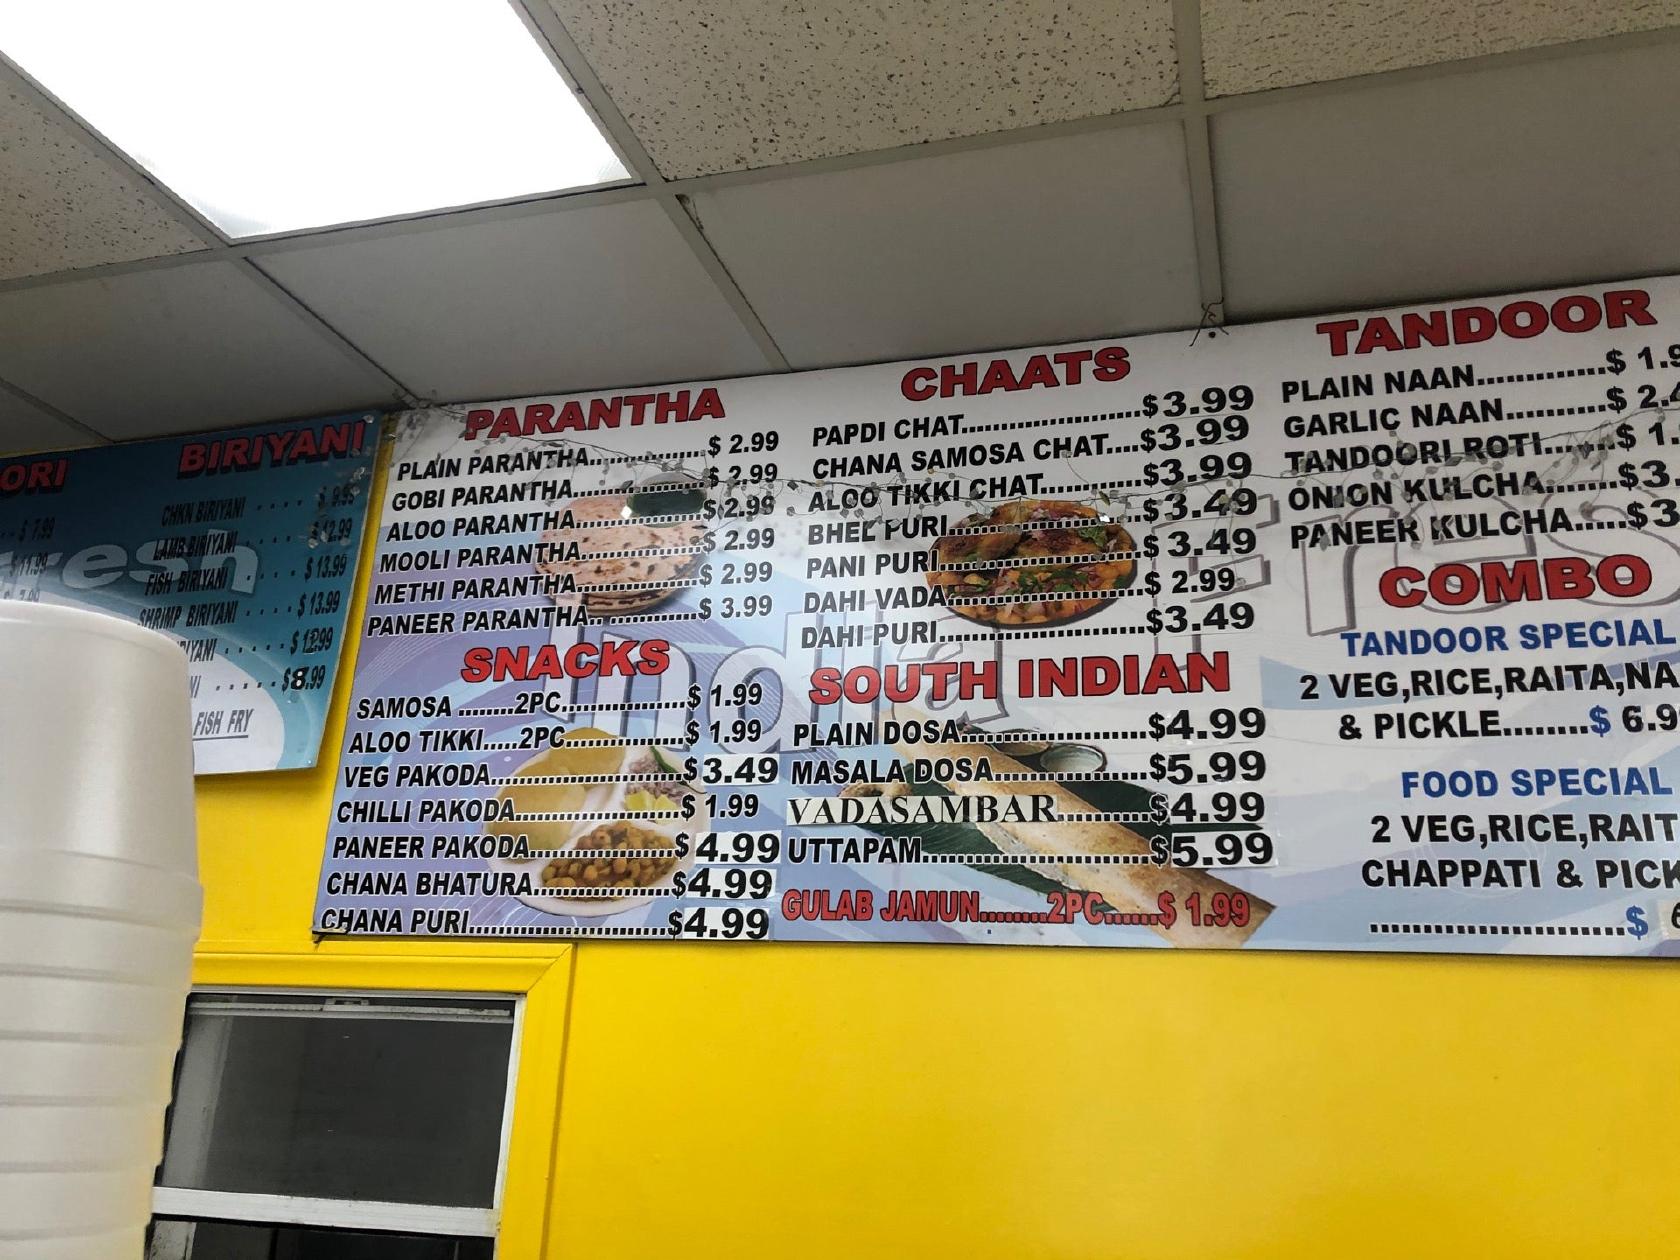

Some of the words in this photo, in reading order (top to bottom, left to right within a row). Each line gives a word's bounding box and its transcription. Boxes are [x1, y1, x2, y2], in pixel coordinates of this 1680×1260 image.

[1316, 290, 1658, 357] TANDOOR
[901, 347, 1131, 401] CHAATS
[1281, 374, 1372, 403] PLAIN
[1385, 364, 1474, 395] NAAN
[1606, 349, 1626, 376] $
[465, 388, 725, 440] PARANTHA
[812, 421, 886, 447] PAPDI
[894, 414, 963, 438] CHAT
[1284, 408, 1400, 439] GARLIC
[1412, 399, 1503, 428] NAAN
[1606, 386, 1627, 413] $
[177, 420, 366, 479] BIRIYANI
[399, 458, 461, 481] PLAIN
[467, 448, 589, 476] PARANTHA
[708, 435, 720, 457] $
[730, 431, 779, 455] 2.99
[813, 452, 901, 480] CHANA
[911, 442, 1024, 472] SAMOSA
[1033, 433, 1108, 459] CHAT
[1285, 439, 1451, 473] TANDOORI
[1463, 432, 1541, 459] ROTI
[1616, 422, 1636, 451] $
[392, 489, 445, 511] GOBI
[450, 479, 572, 507] PARANTHA
[707, 467, 720, 488] $
[728, 463, 778, 485] 2.99
[808, 487, 878, 512] ALOO
[888, 481, 961, 507] TIKKI
[969, 473, 1043, 499] CHAT
[1288, 480, 1392, 511] ONION
[1404, 471, 1544, 503] KULCHA
[162, 502, 196, 527] CHKN
[196, 497, 246, 524] BIRIYANI
[386, 519, 446, 543] ALOO
[452, 510, 575, 537] PARANTHA
[703, 499, 716, 521] $
[724, 495, 775, 518] 2.99
[808, 516, 876, 545] BHEL
[884, 513, 947, 540] PURI
[1291, 518, 1417, 549] PANEER
[1431, 508, 1573, 541] KULCHA
[153, 537, 187, 561] LAMB
[187, 531, 238, 557] BIRIYANI
[380, 549, 450, 574] MOOLI
[456, 542, 580, 569] PARANTHA
[702, 532, 716, 553] $
[724, 527, 775, 551] 2.99
[806, 553, 865, 579] PANI
[875, 550, 938, 575] PURI
[145, 572, 173, 596] FISH
[178, 566, 229, 593] BIRIYANI
[317, 553, 348, 578] 13.99
[374, 580, 445, 605] METHI
[450, 574, 576, 601] PARANTHA
[700, 564, 712, 587] $
[722, 561, 773, 586] 2.99
[803, 588, 866, 614] DAHI
[875, 585, 945, 609] VADA
[1144, 570, 1161, 596] $
[1171, 568, 1235, 595] 2.99
[1379, 554, 1652, 608] COMBO
[138, 605, 182, 629] SHRIMP
[186, 600, 238, 627] BIRIYANI
[310, 590, 340, 614] 13.99
[368, 611, 456, 637] PANEER
[462, 605, 589, 632] PARANTHA
[699, 598, 712, 620] $
[721, 595, 773, 618] 3.99
[801, 623, 864, 648] DAHI
[872, 621, 937, 646] PURI
[1340, 625, 1508, 656] TANDOOR
[1520, 619, 1676, 649] SPECIAL
[460, 640, 670, 682] SNACKS
[808, 660, 1000, 706] SOUTH
[1018, 651, 1230, 698] INDIAN
[357, 696, 452, 720] SAMOSA
[514, 691, 561, 714] 2PC
[687, 686, 700, 710] $
[710, 683, 763, 707] 1.99
[1300, 675, 1319, 699] 2
[193, 711, 224, 736] FISH
[227, 708, 254, 733] FRY
[348, 730, 414, 753] ALOO
[419, 728, 483, 752] TIKKI
[520, 726, 565, 749] 2PC
[686, 723, 699, 746] $
[709, 719, 762, 744] 1.99
[793, 722, 874, 747] PLAIN
[883, 720, 960, 744] DOSA
[1339, 714, 1362, 739] &
[1374, 710, 1500, 739] PICKLE
[1590, 705, 1611, 737] $
[344, 765, 390, 788] VEG
[395, 763, 490, 787] PAKODA
[791, 759, 912, 785] MASALA
[914, 757, 994, 784] DOSA
[1401, 770, 1499, 798] FOOD
[1512, 767, 1672, 796] SPECIAL
[337, 800, 410, 823] CHILLI
[418, 798, 515, 822] PAKODA
[681, 795, 695, 820] $
[705, 794, 758, 818] 1.99
[789, 794, 1057, 824] VADASAMBAR
[332, 836, 425, 860] PANEER
[430, 835, 530, 859] PAKODA
[1372, 816, 1391, 843] 2
[788, 837, 921, 864] UTTAPAM
[326, 872, 406, 896] CHANA
[419, 871, 533, 896] BHATURA
[1362, 859, 1540, 888] CHAPPATI
[1556, 860, 1583, 888] &
[321, 908, 403, 934] CHANA
[410, 909, 469, 934] PURI
[782, 889, 873, 922] GULAB
[880, 890, 980, 922] JAMUN
[1046, 892, 1103, 924] 2PC
[1157, 896, 1177, 929] $
[1186, 893, 1250, 927] 1.99
[1626, 906, 1649, 940] $
